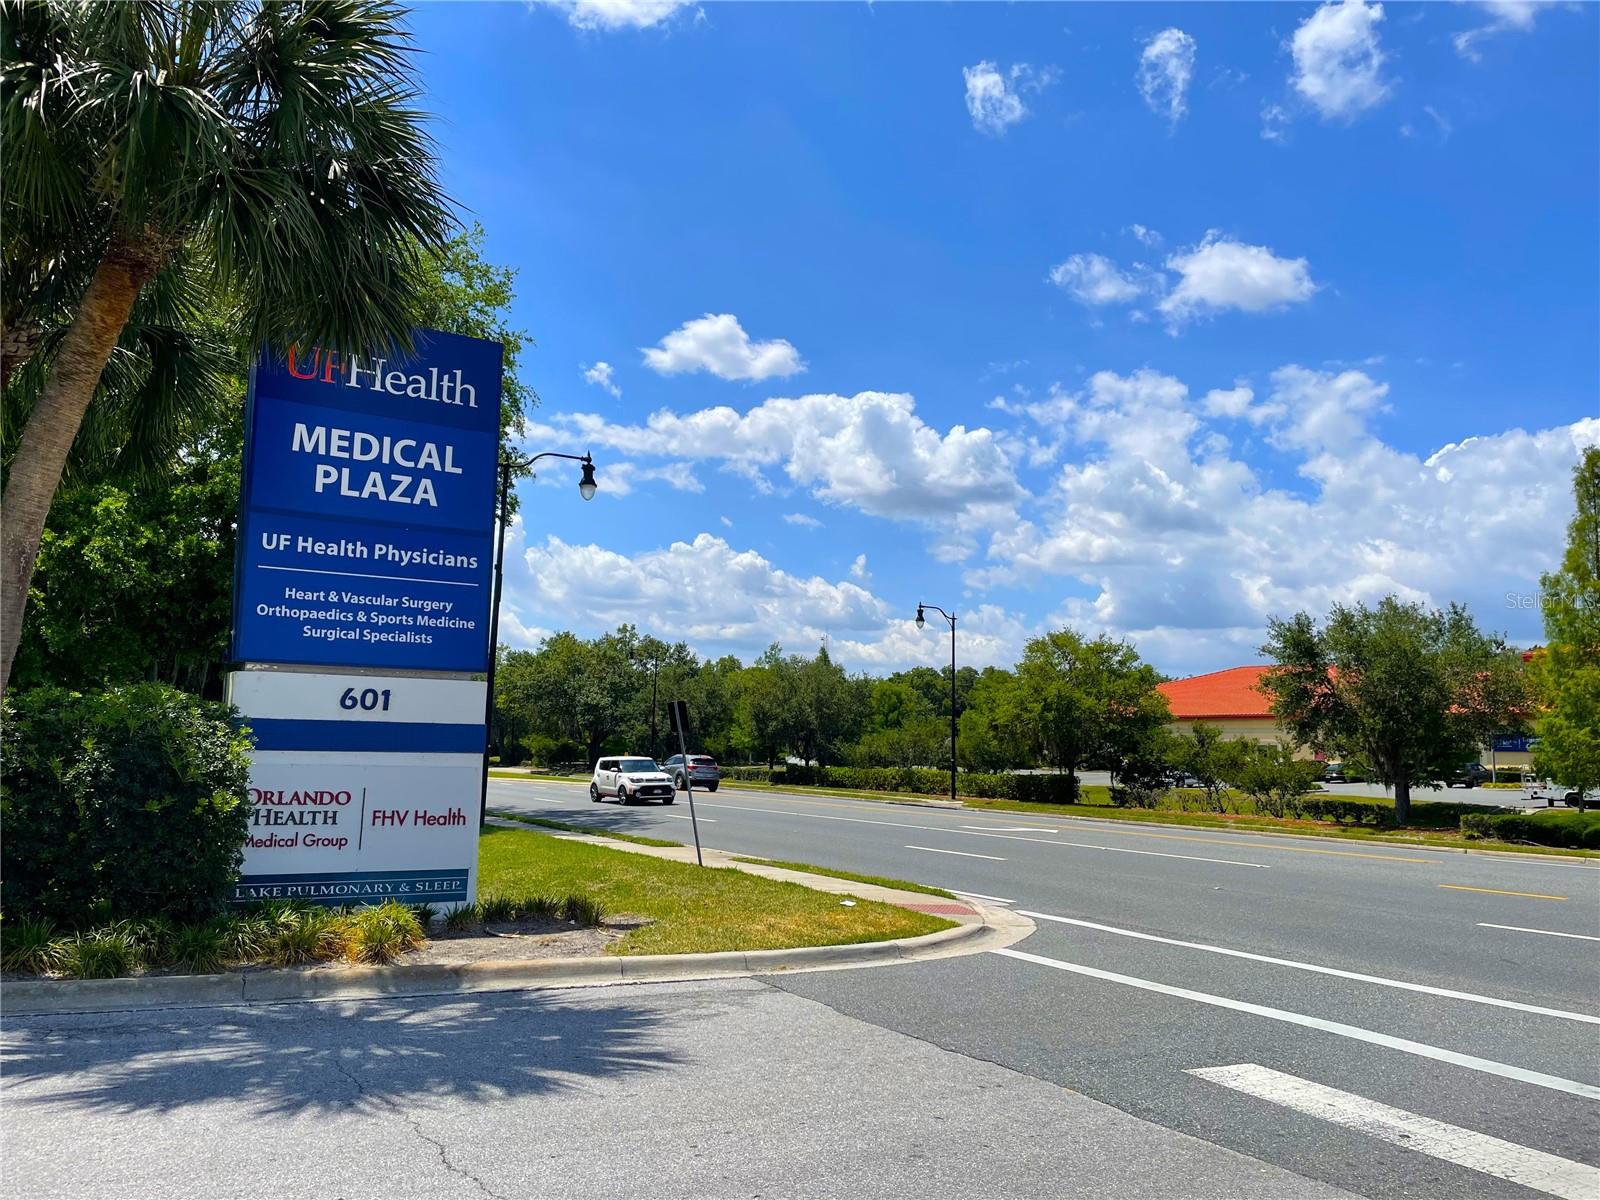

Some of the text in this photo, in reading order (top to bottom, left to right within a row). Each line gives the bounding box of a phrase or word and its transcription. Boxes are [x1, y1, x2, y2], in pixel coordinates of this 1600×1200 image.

[292, 422, 463, 474] MEDICAL
[315, 464, 438, 507] PLAZA
[261, 532, 478, 569] UF Health Physicians
[285, 587, 453, 613] Heart & Vascular Surgery
[256, 604, 475, 630] Orthopaedics & Sports Medicine
[303, 626, 433, 645] Surgical Specialists
[339, 687, 391, 711] 601
[247, 788, 352, 806] ORLANDO
[253, 808, 339, 826] HEALTH
[372, 808, 466, 827] FHV Health
[303, 833, 348, 850] Group
[235, 886, 282, 899] LAKE
[287, 883, 395, 898] PULMONARY
[399, 882, 411, 893] &
